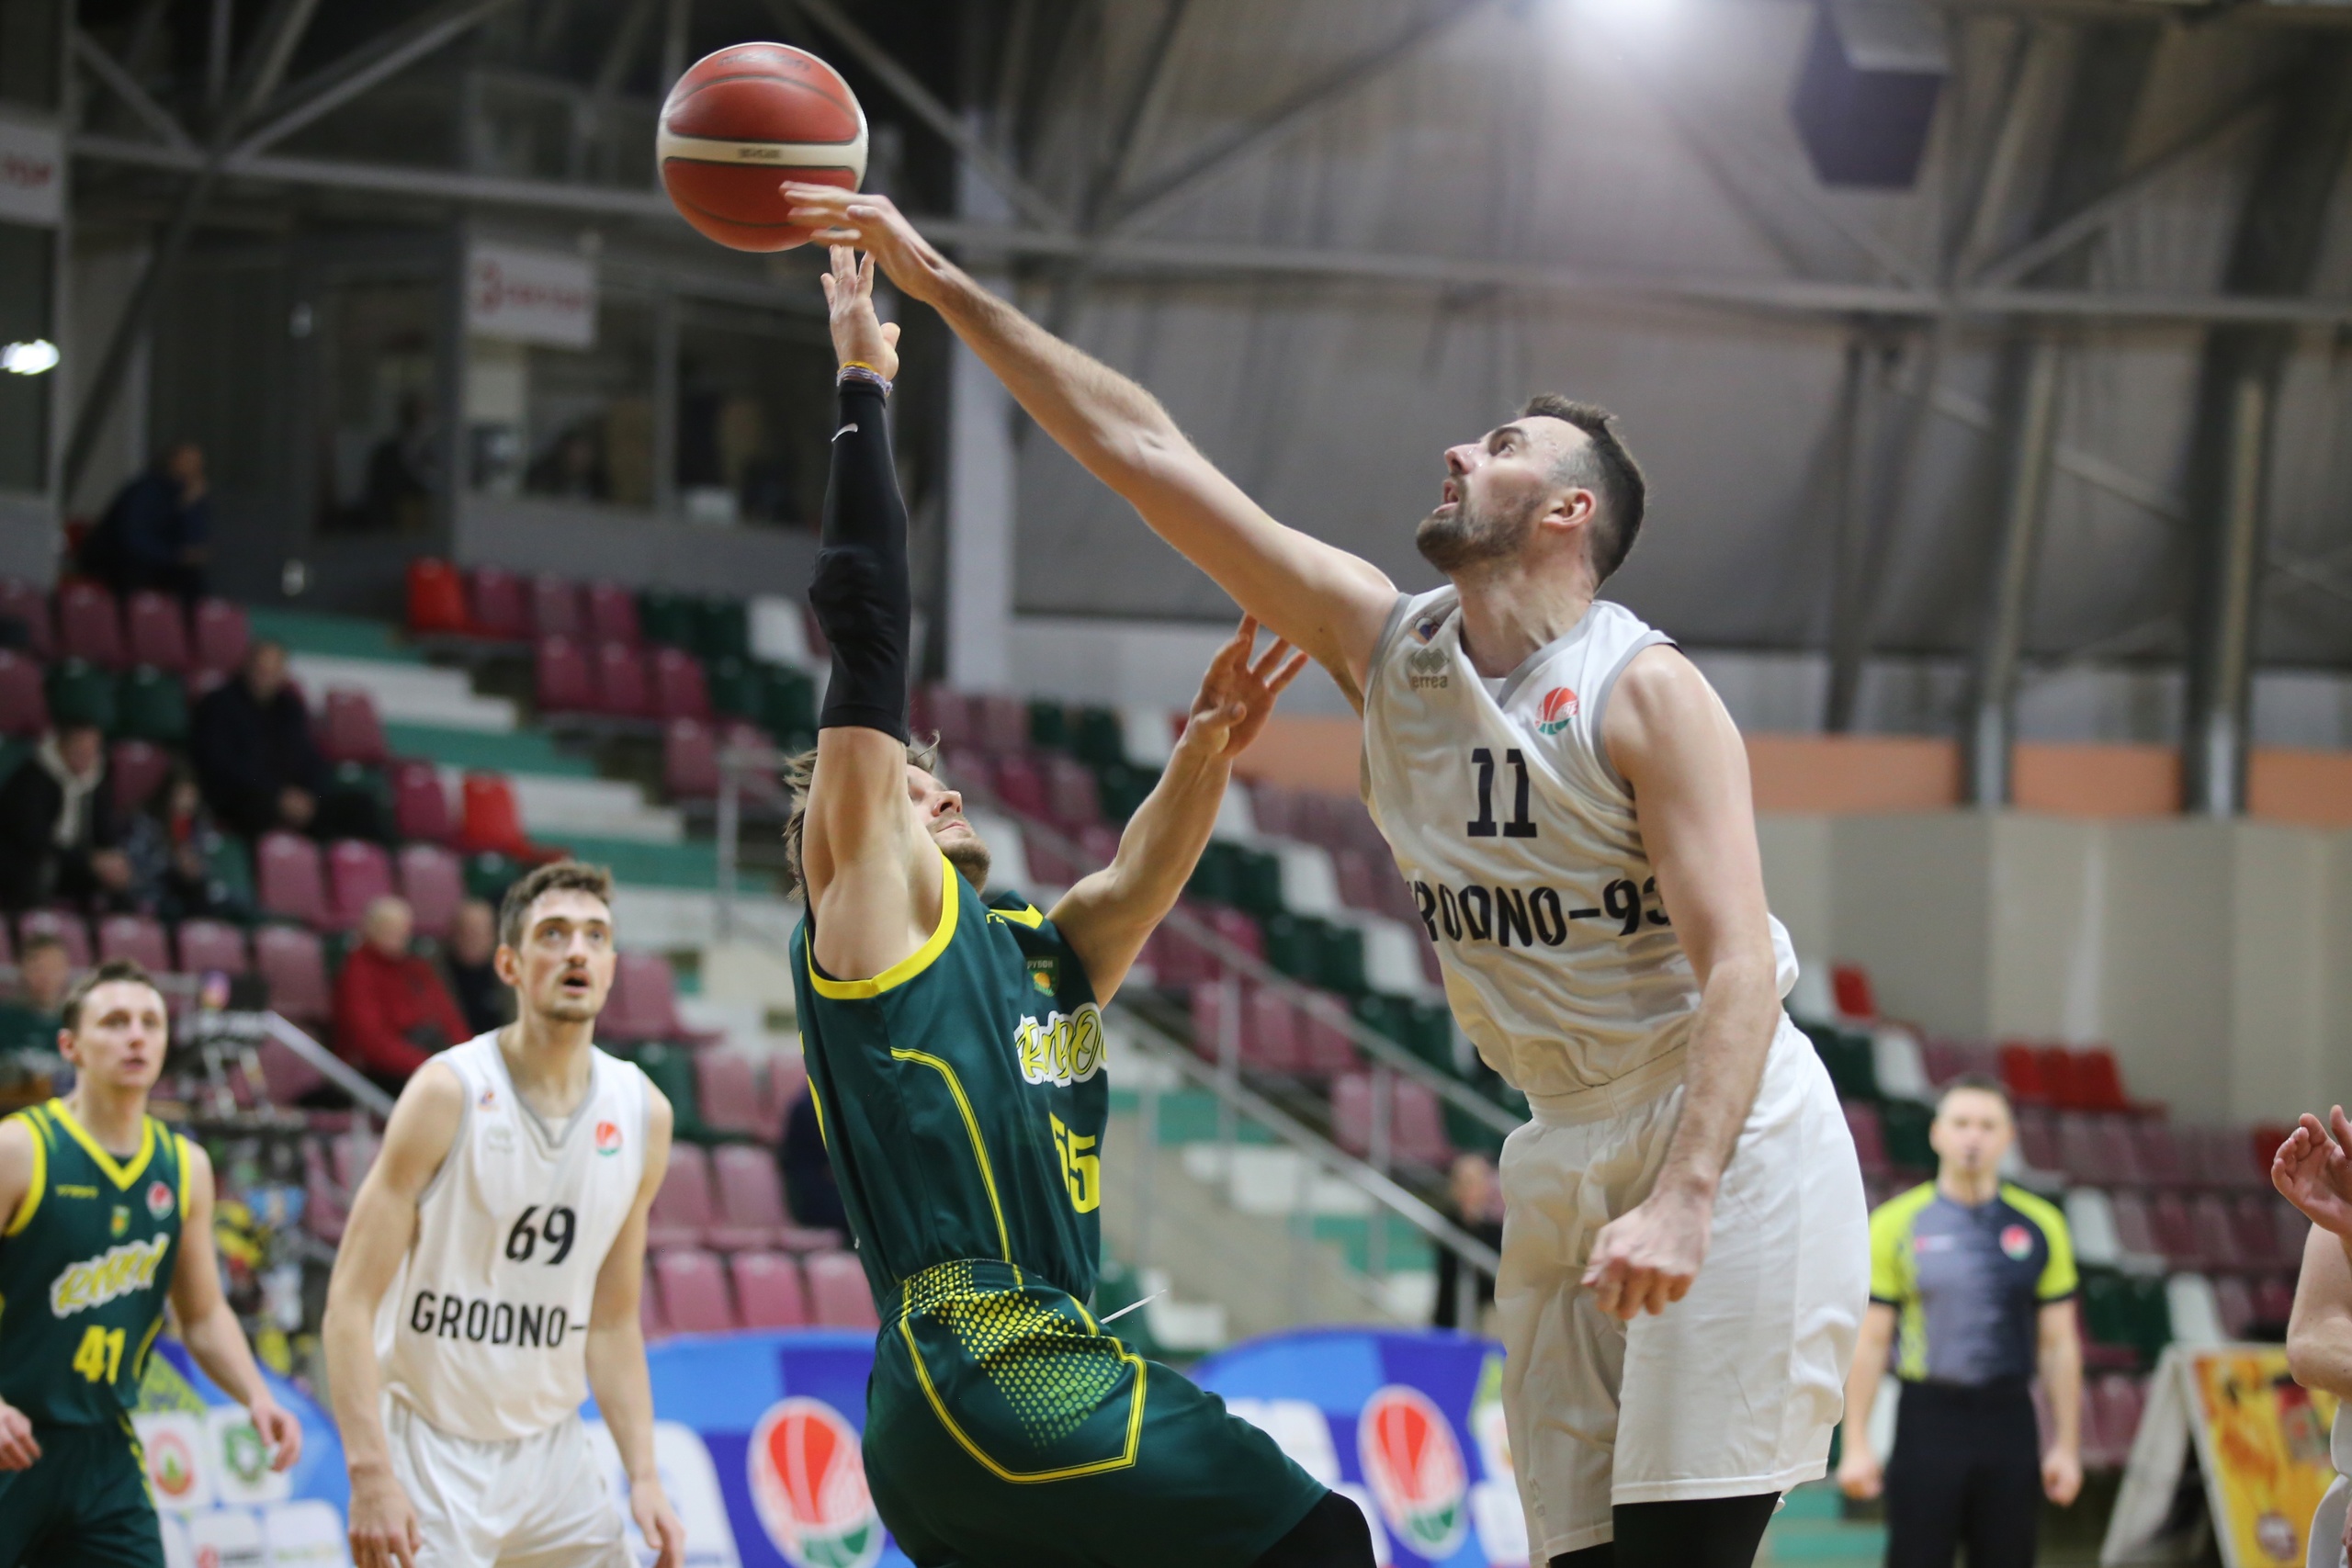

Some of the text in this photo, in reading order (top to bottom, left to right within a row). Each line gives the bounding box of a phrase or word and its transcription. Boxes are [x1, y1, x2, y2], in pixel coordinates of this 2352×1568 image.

[1467, 748, 1537, 838] 11
[1409, 875, 1671, 948] RODNO-93
[504, 1203, 576, 1266] 69
[73, 1325, 126, 1385] 41
